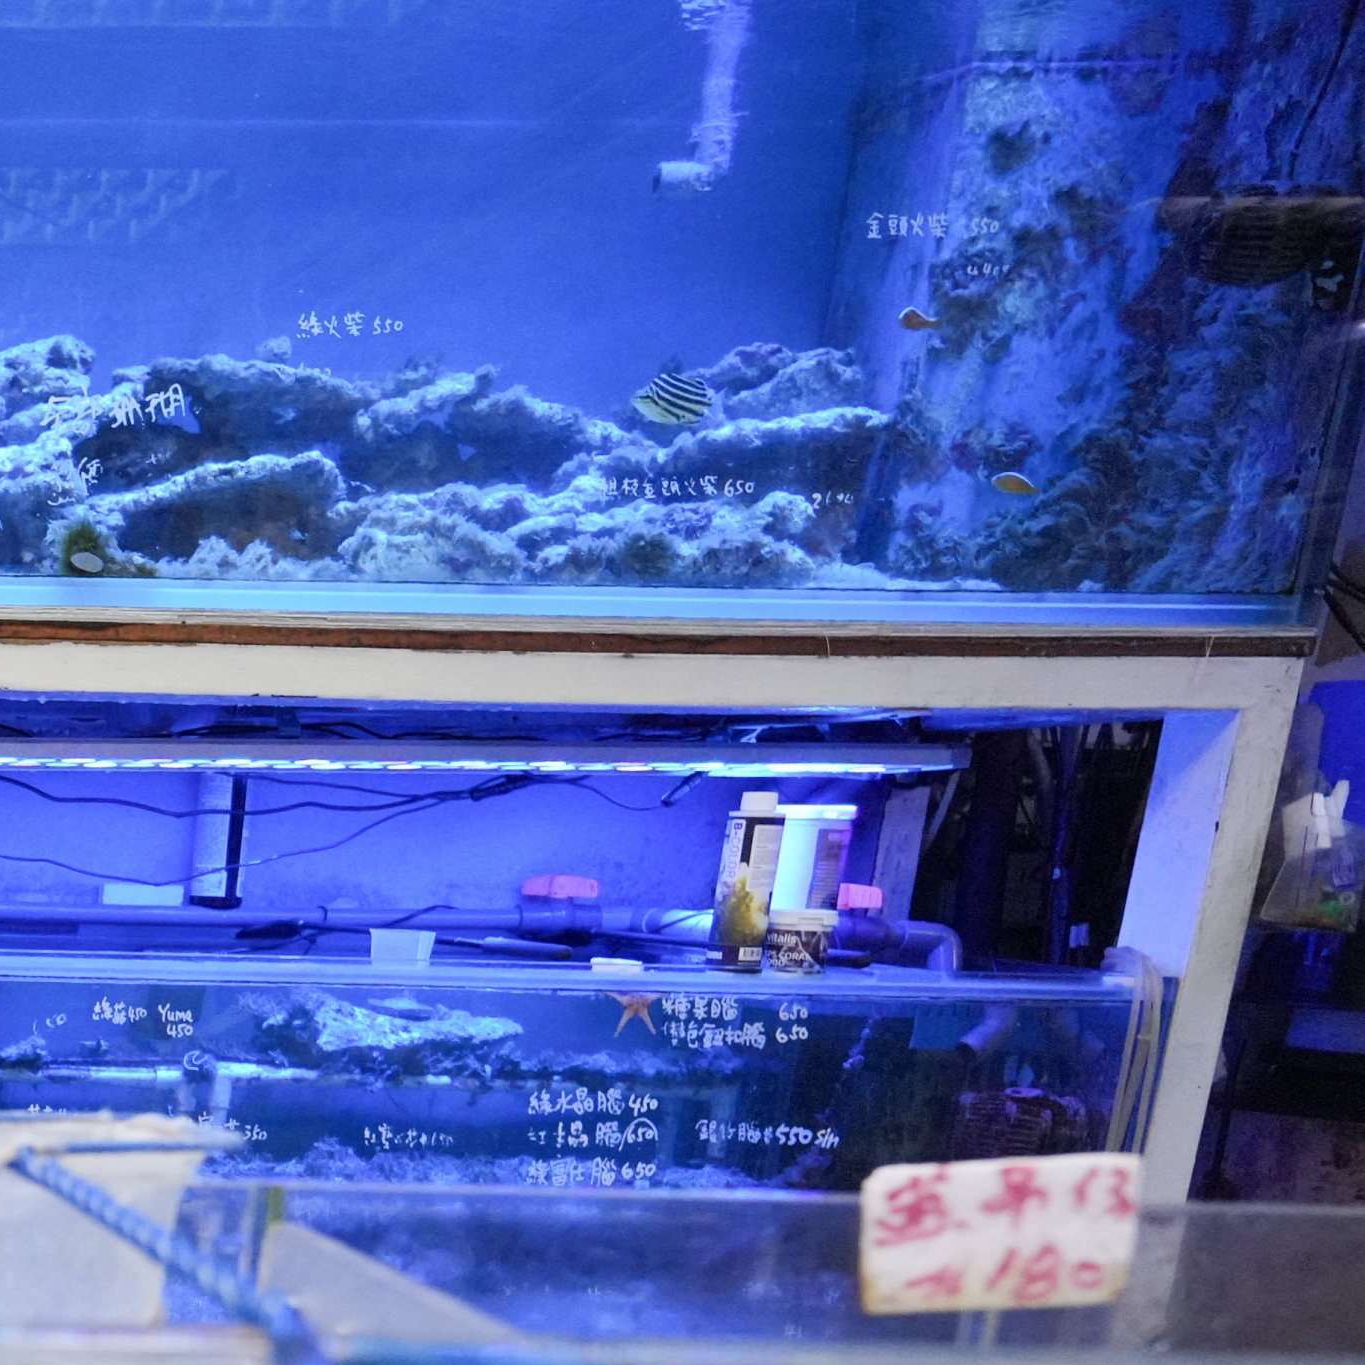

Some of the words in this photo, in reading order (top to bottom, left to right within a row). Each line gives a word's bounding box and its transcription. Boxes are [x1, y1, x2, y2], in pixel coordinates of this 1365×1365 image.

[372, 315, 404, 335] 550
[723, 478, 755, 498] 650
[128, 1005, 148, 1024] 450
[778, 1002, 809, 1021] 650
[166, 1022, 193, 1038] 450
[775, 1024, 809, 1044] 650
[628, 1093, 659, 1117] 450
[621, 1160, 657, 1180] 650
